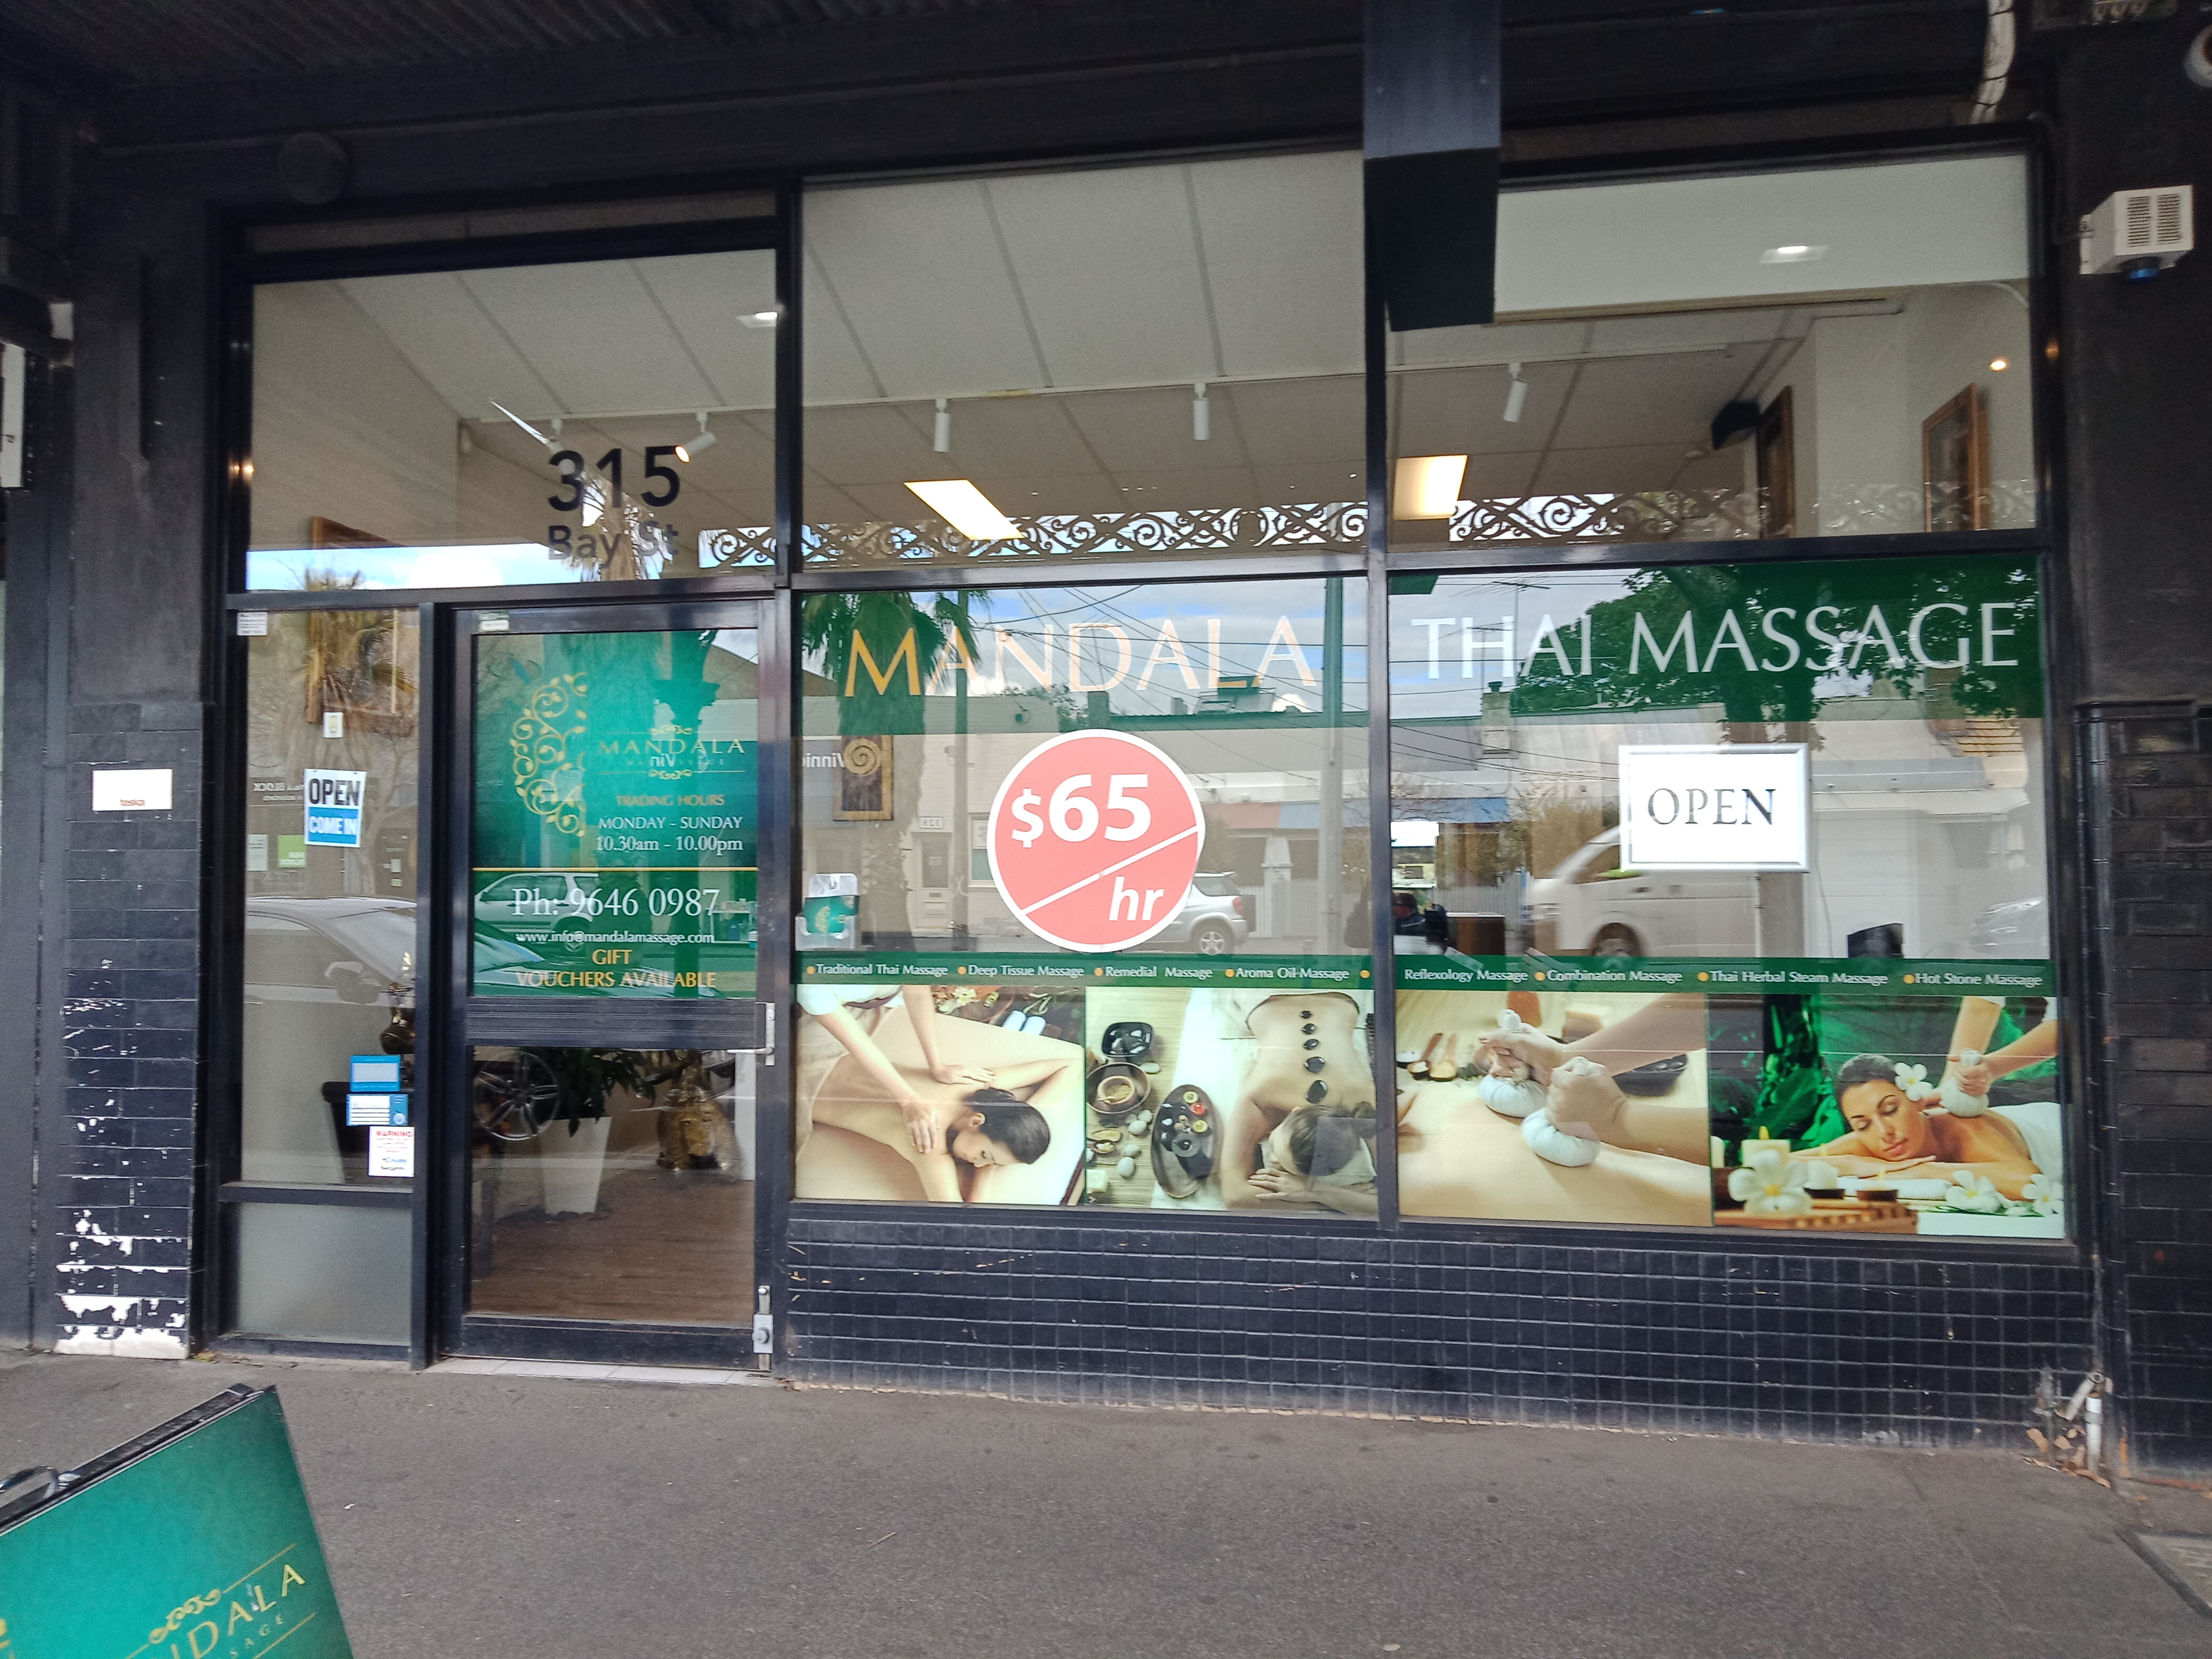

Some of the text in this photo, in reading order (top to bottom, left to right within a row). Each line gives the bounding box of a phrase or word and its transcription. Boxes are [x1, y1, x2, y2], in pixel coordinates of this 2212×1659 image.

[548, 445, 680, 511] 315
[548, 521, 678, 568] Bay St
[844, 602, 2018, 697] MANDALA THAI MASSAGE
[598, 739, 745, 755] MANDALA
[309, 778, 361, 806] OPEN
[616, 795, 725, 806] TRADING HOURS
[1648, 788, 1776, 825] OPEN
[1010, 774, 1151, 848] $65
[309, 816, 357, 835] COME IN
[599, 816, 666, 830] MONDAY
[680, 816, 743, 829] SUNDAY
[596, 835, 659, 851] 10.30am
[676, 835, 743, 856] 10.00pm
[512, 887, 720, 916] Ph: 9646 0987
[1109, 876, 1164, 921] hr
[516, 930, 714, 945] www.info@mandalamassage.com
[592, 949, 632, 965] GIFT
[516, 970, 716, 987] VOUCHERS AVAILABLE
[816, 963, 948, 978] Traditional Thai Massage
[969, 965, 1084, 978] Deep Tissue Massage
[1105, 967, 1213, 980] Remedial Massage
[1236, 968, 1273, 978] Aroma
[1404, 969, 1528, 983] Reflexology Massage
[1547, 970, 1683, 984] Combination Massage
[1709, 971, 1888, 986] Thai Herbal Steam Massage
[1916, 973, 2042, 987] Hot Stone Massage
[171, 1564, 305, 1659] DALA
